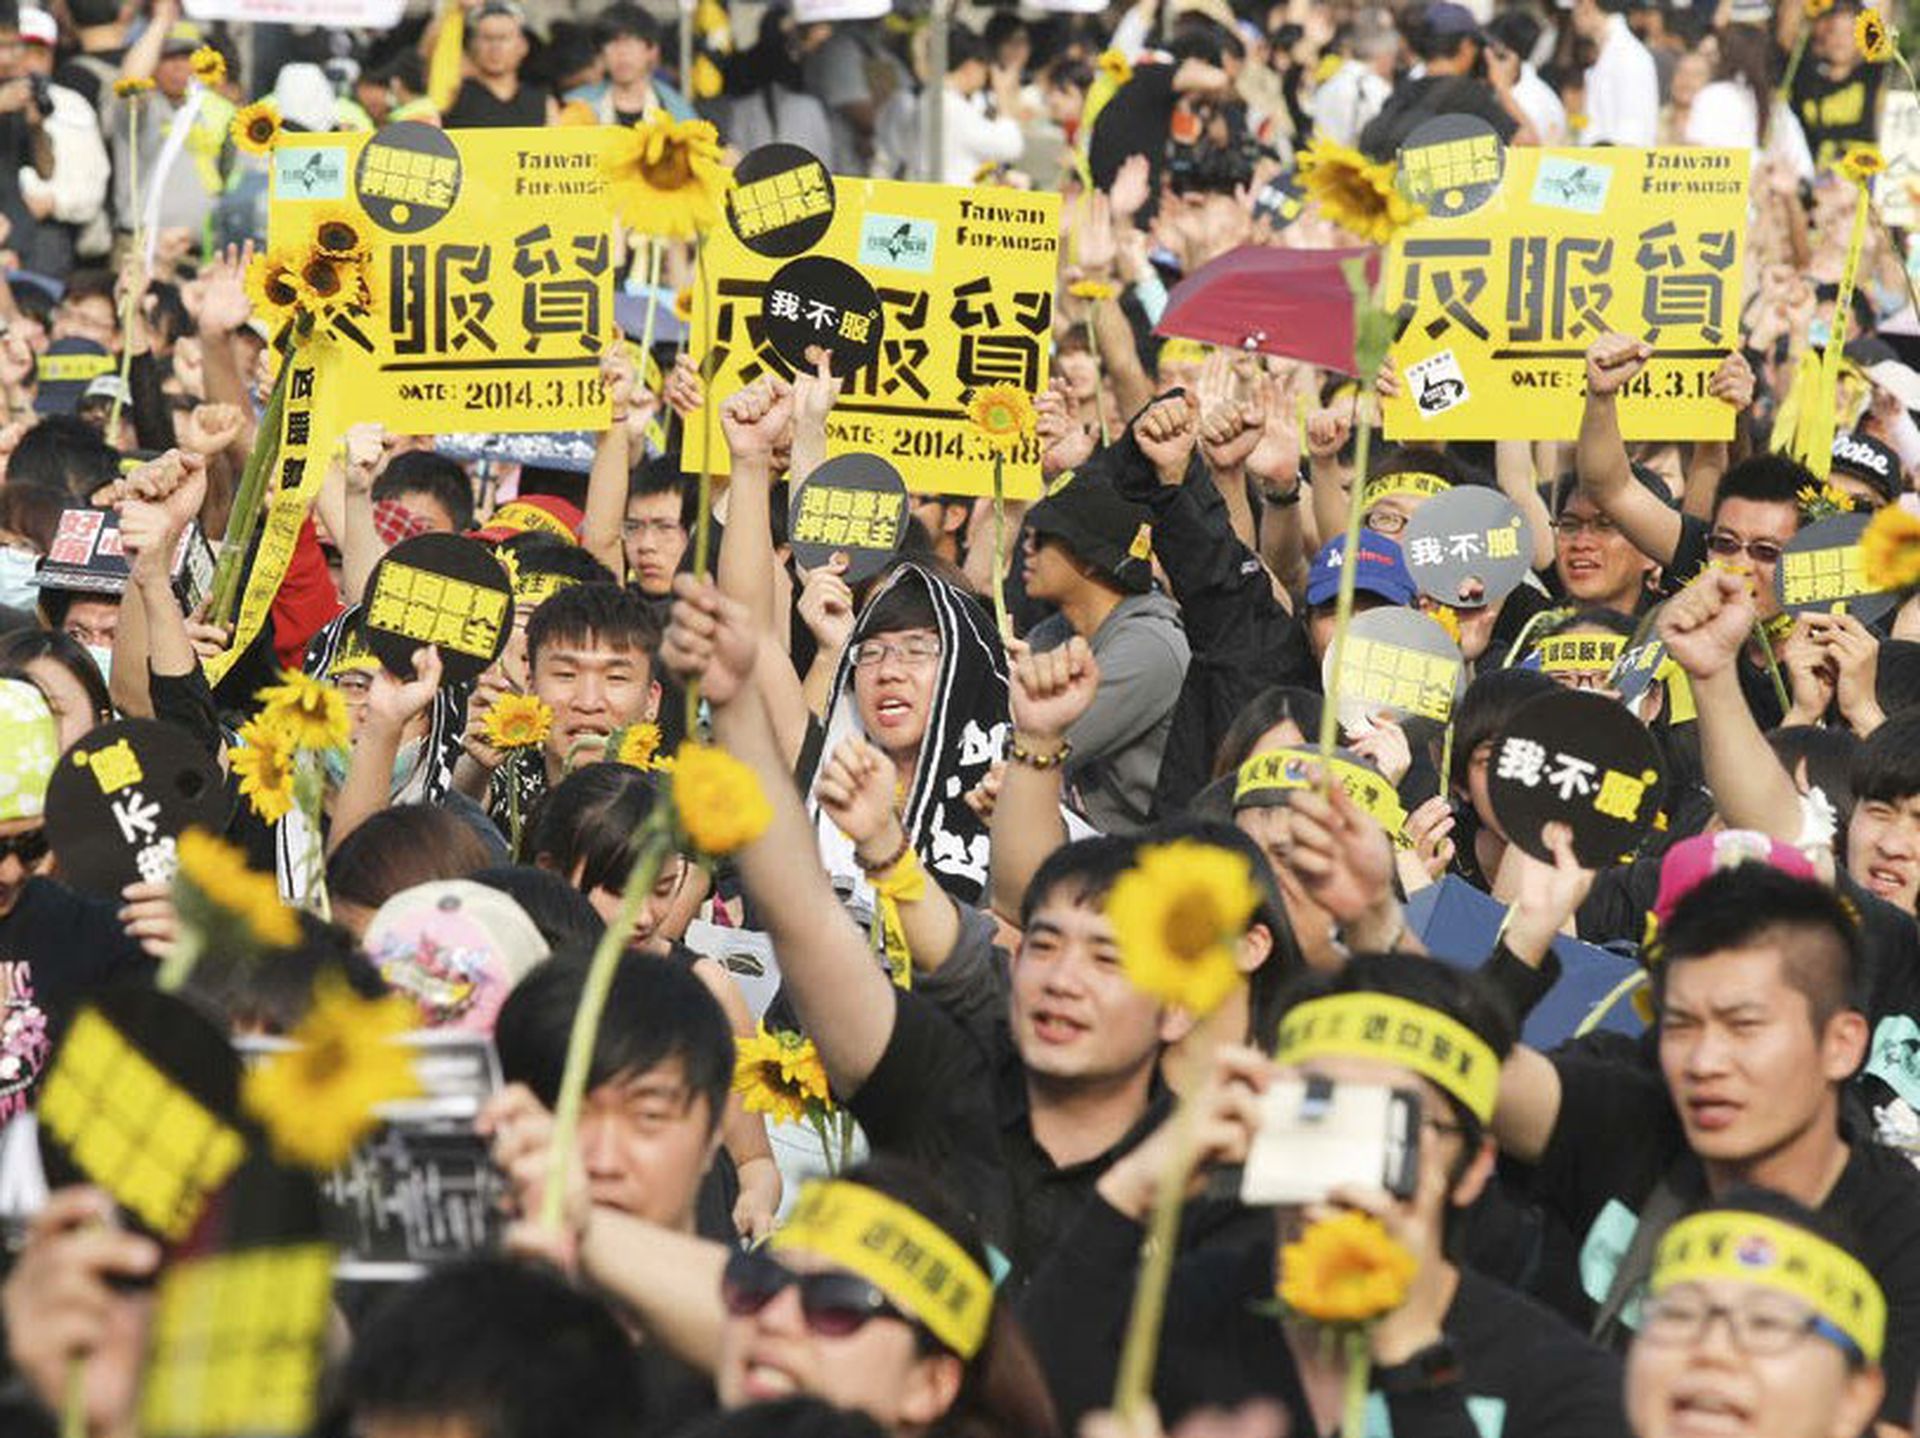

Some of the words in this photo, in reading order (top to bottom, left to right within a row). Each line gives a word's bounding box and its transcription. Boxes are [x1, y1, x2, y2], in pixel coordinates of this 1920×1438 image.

[1645, 153, 1731, 169] Taiwan
[960, 200, 1046, 224] Taiwan
[956, 226, 1057, 252] Formosa
[273, 224, 608, 355] 服貿
[1395, 221, 1735, 344] 反服貿
[464, 381, 607, 410] 2014.3.18
[1579, 371, 1716, 399] 14.3.1
